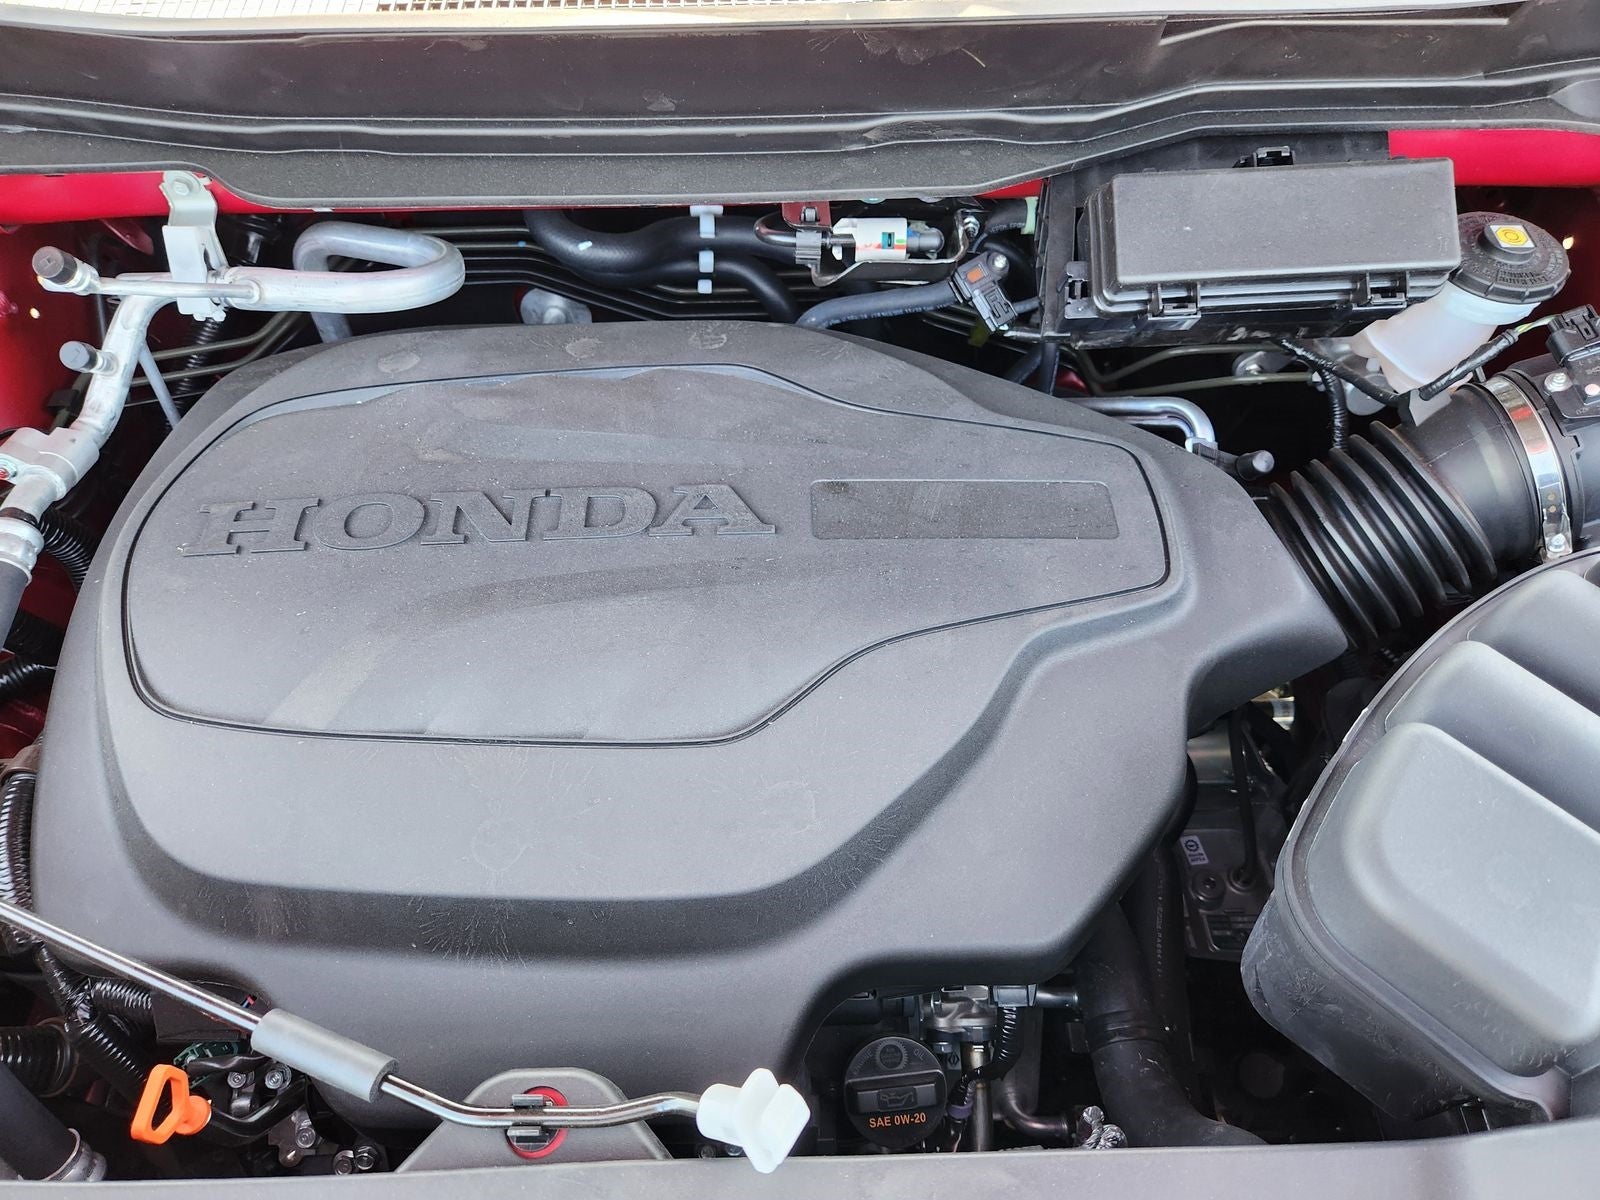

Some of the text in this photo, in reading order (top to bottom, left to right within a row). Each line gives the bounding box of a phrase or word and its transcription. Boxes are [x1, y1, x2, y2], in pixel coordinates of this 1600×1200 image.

[182, 484, 776, 557] HONDA
[869, 1112, 927, 1128] SAE 0W-20
